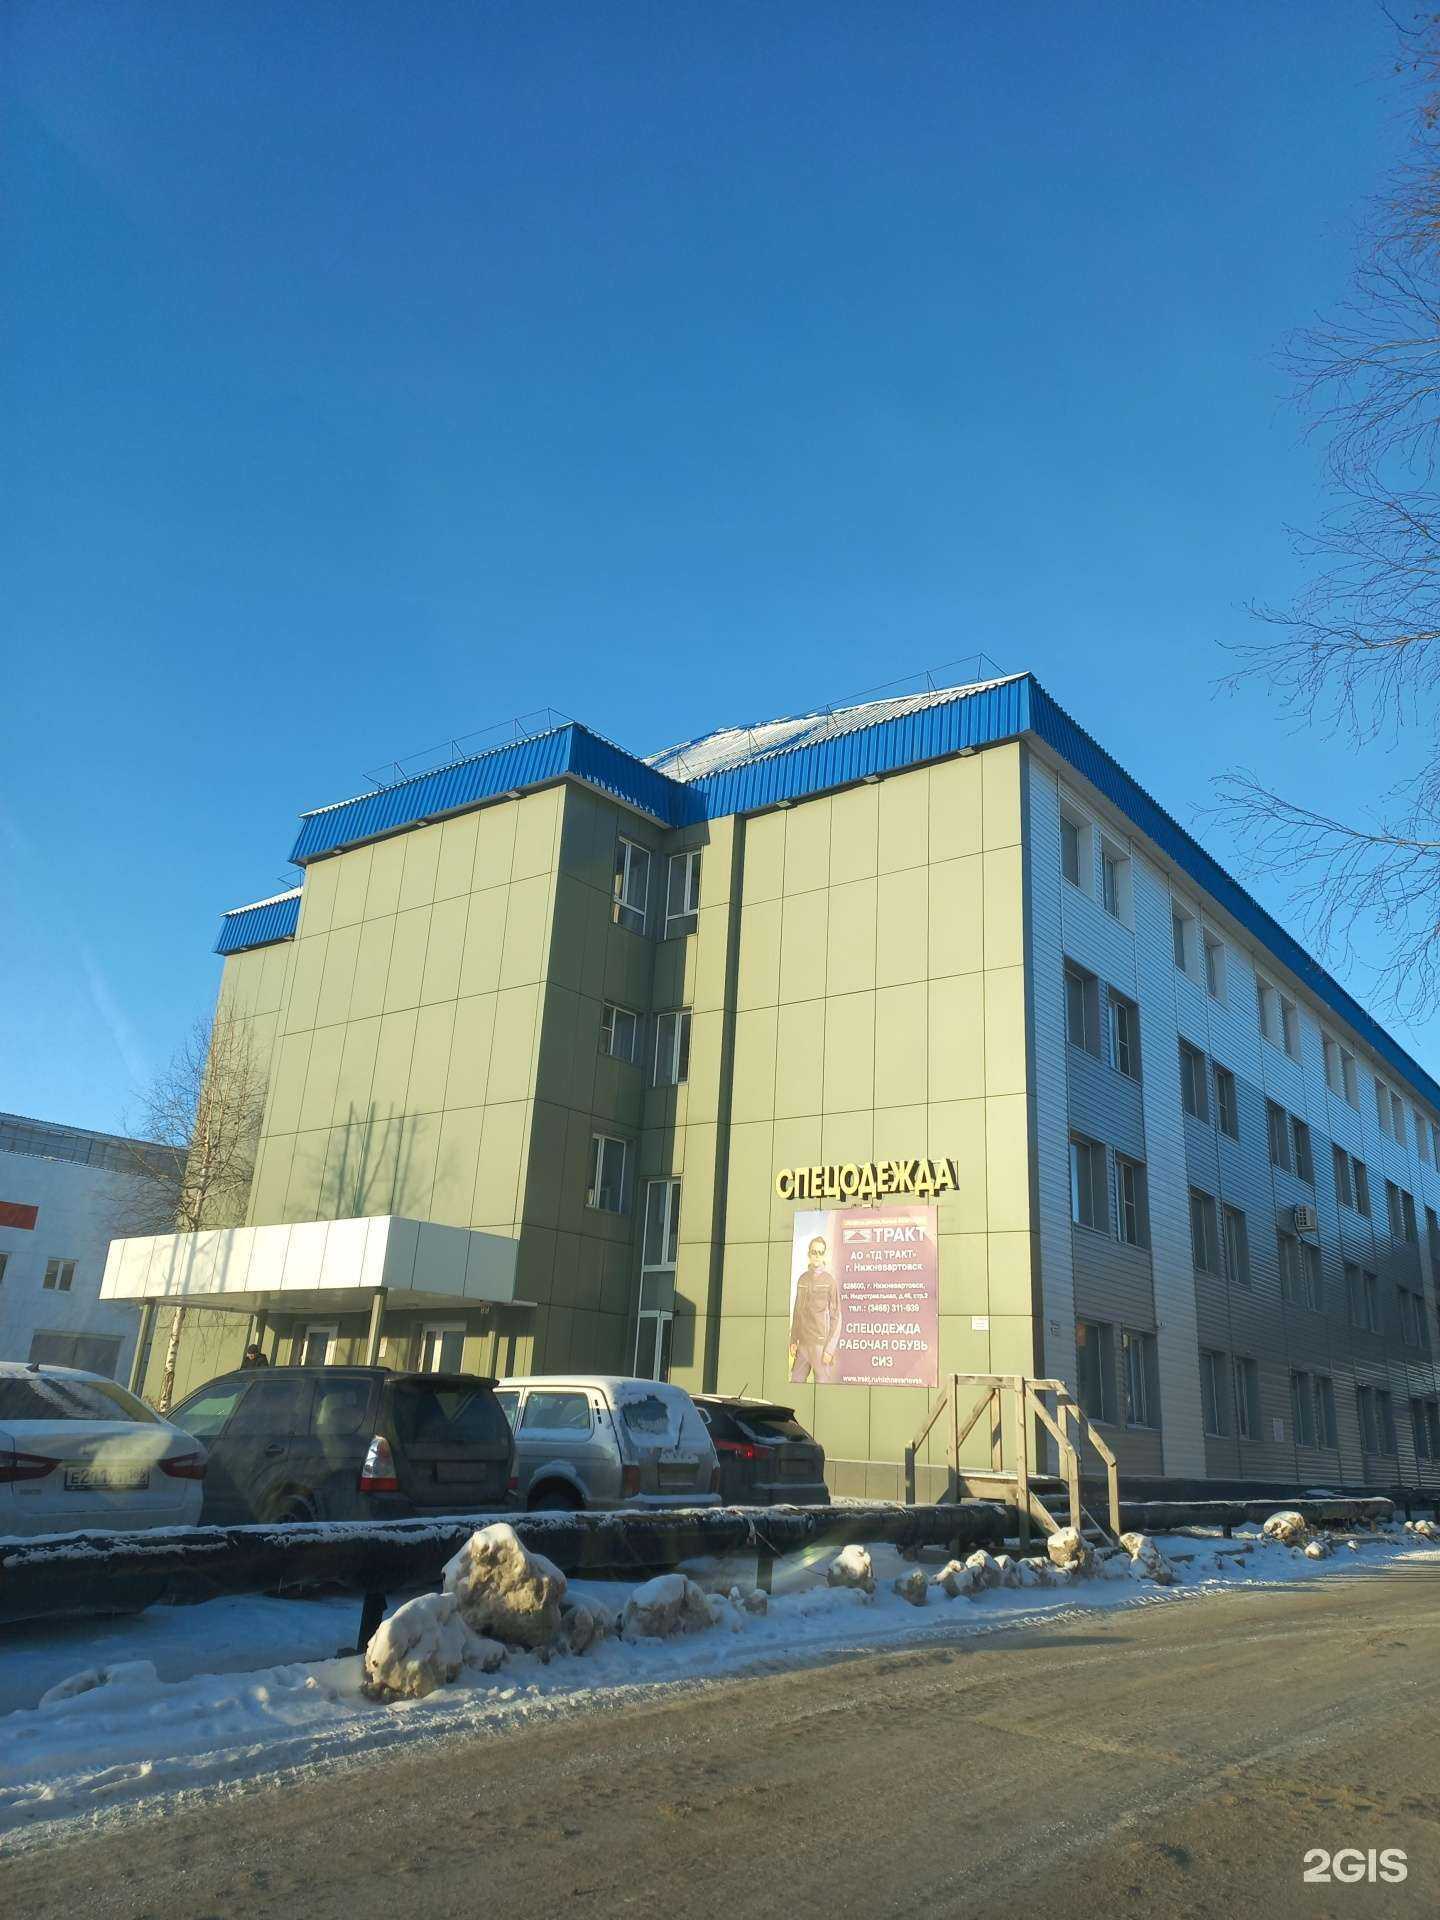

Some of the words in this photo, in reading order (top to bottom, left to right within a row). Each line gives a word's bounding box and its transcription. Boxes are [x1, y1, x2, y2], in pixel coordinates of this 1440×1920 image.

[775, 1157, 957, 1201] СПЕЦОДЕЖДА
[873, 1226, 926, 1243] ТРАКТ
[850, 1251, 864, 1260] АО
[854, 1263, 923, 1273] Нижневартовск
[846, 1323, 921, 1335] СПЕЦОДЕЖДА
[839, 1340, 888, 1350] РАБОЧАЯ
[891, 1340, 928, 1351] ОБУВЬ
[871, 1356, 893, 1367] СИЗ
